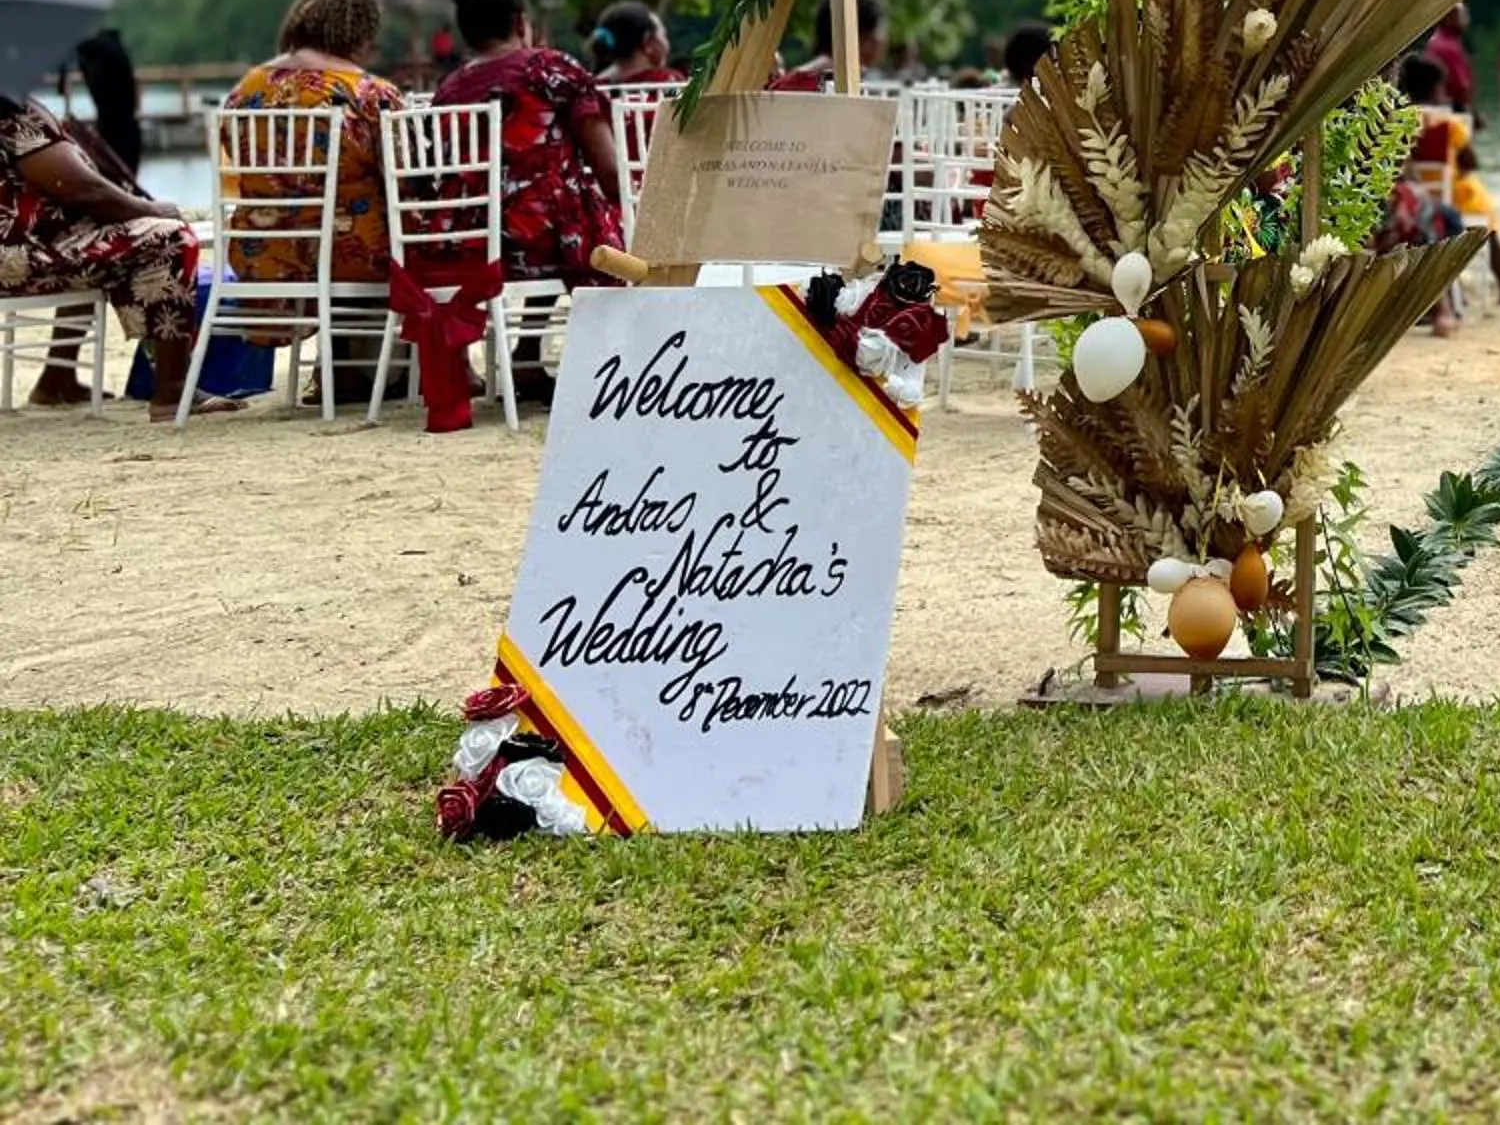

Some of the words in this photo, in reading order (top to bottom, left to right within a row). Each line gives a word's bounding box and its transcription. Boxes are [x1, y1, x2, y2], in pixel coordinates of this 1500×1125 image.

[589, 331, 784, 421] Welcome
[718, 414, 800, 473] to
[558, 466, 697, 536] Andras
[645, 513, 848, 601] Natasha's
[539, 566, 728, 705] Wedding
[806, 679, 872, 719] 2022
